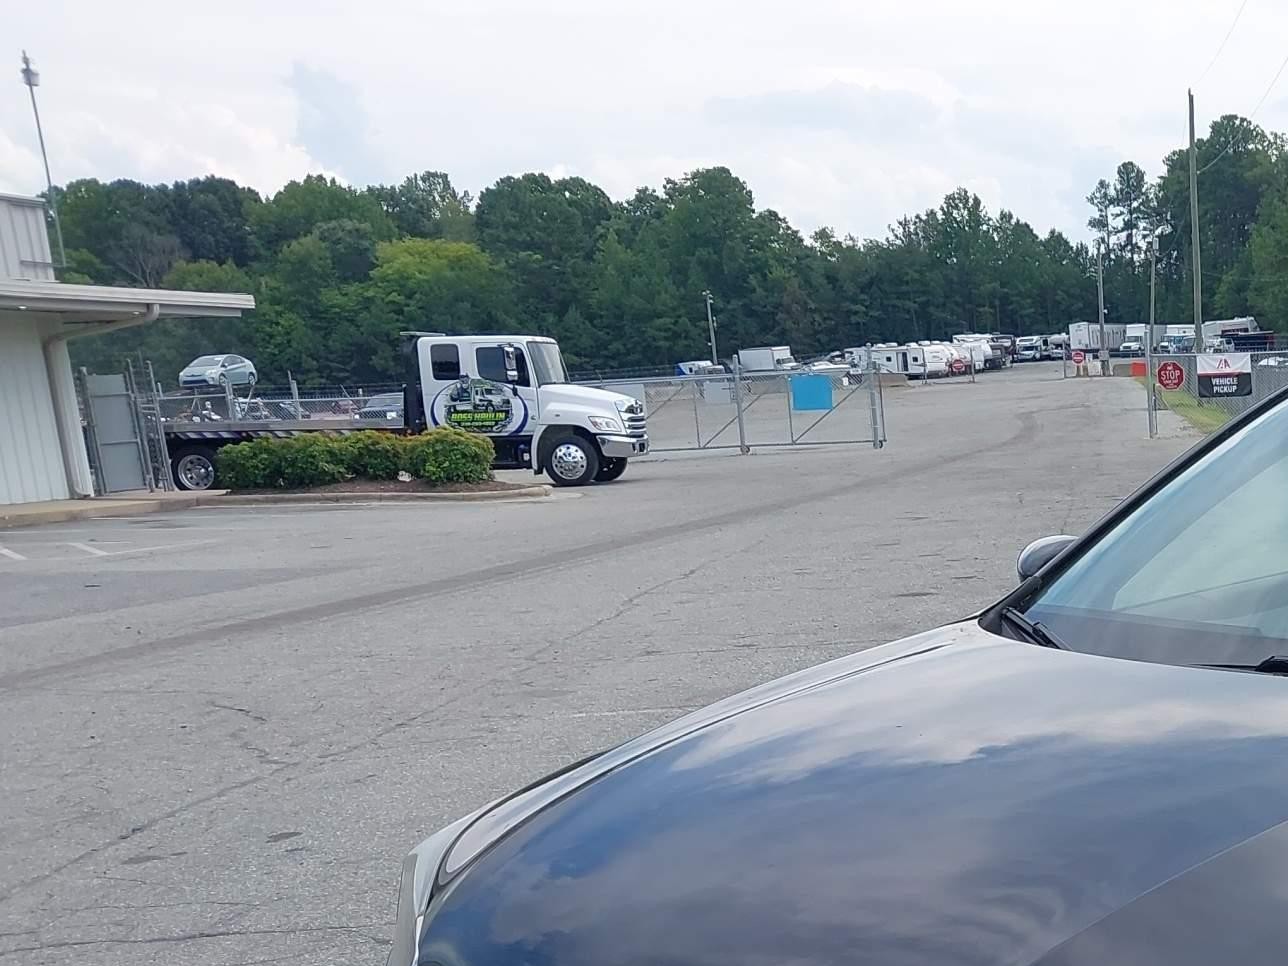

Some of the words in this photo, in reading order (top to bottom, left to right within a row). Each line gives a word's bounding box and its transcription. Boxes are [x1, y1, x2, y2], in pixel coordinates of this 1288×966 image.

[1160, 369, 1181, 381] STOP
[1211, 377, 1239, 386] VEHICLE
[1213, 385, 1238, 394] PICKUP
